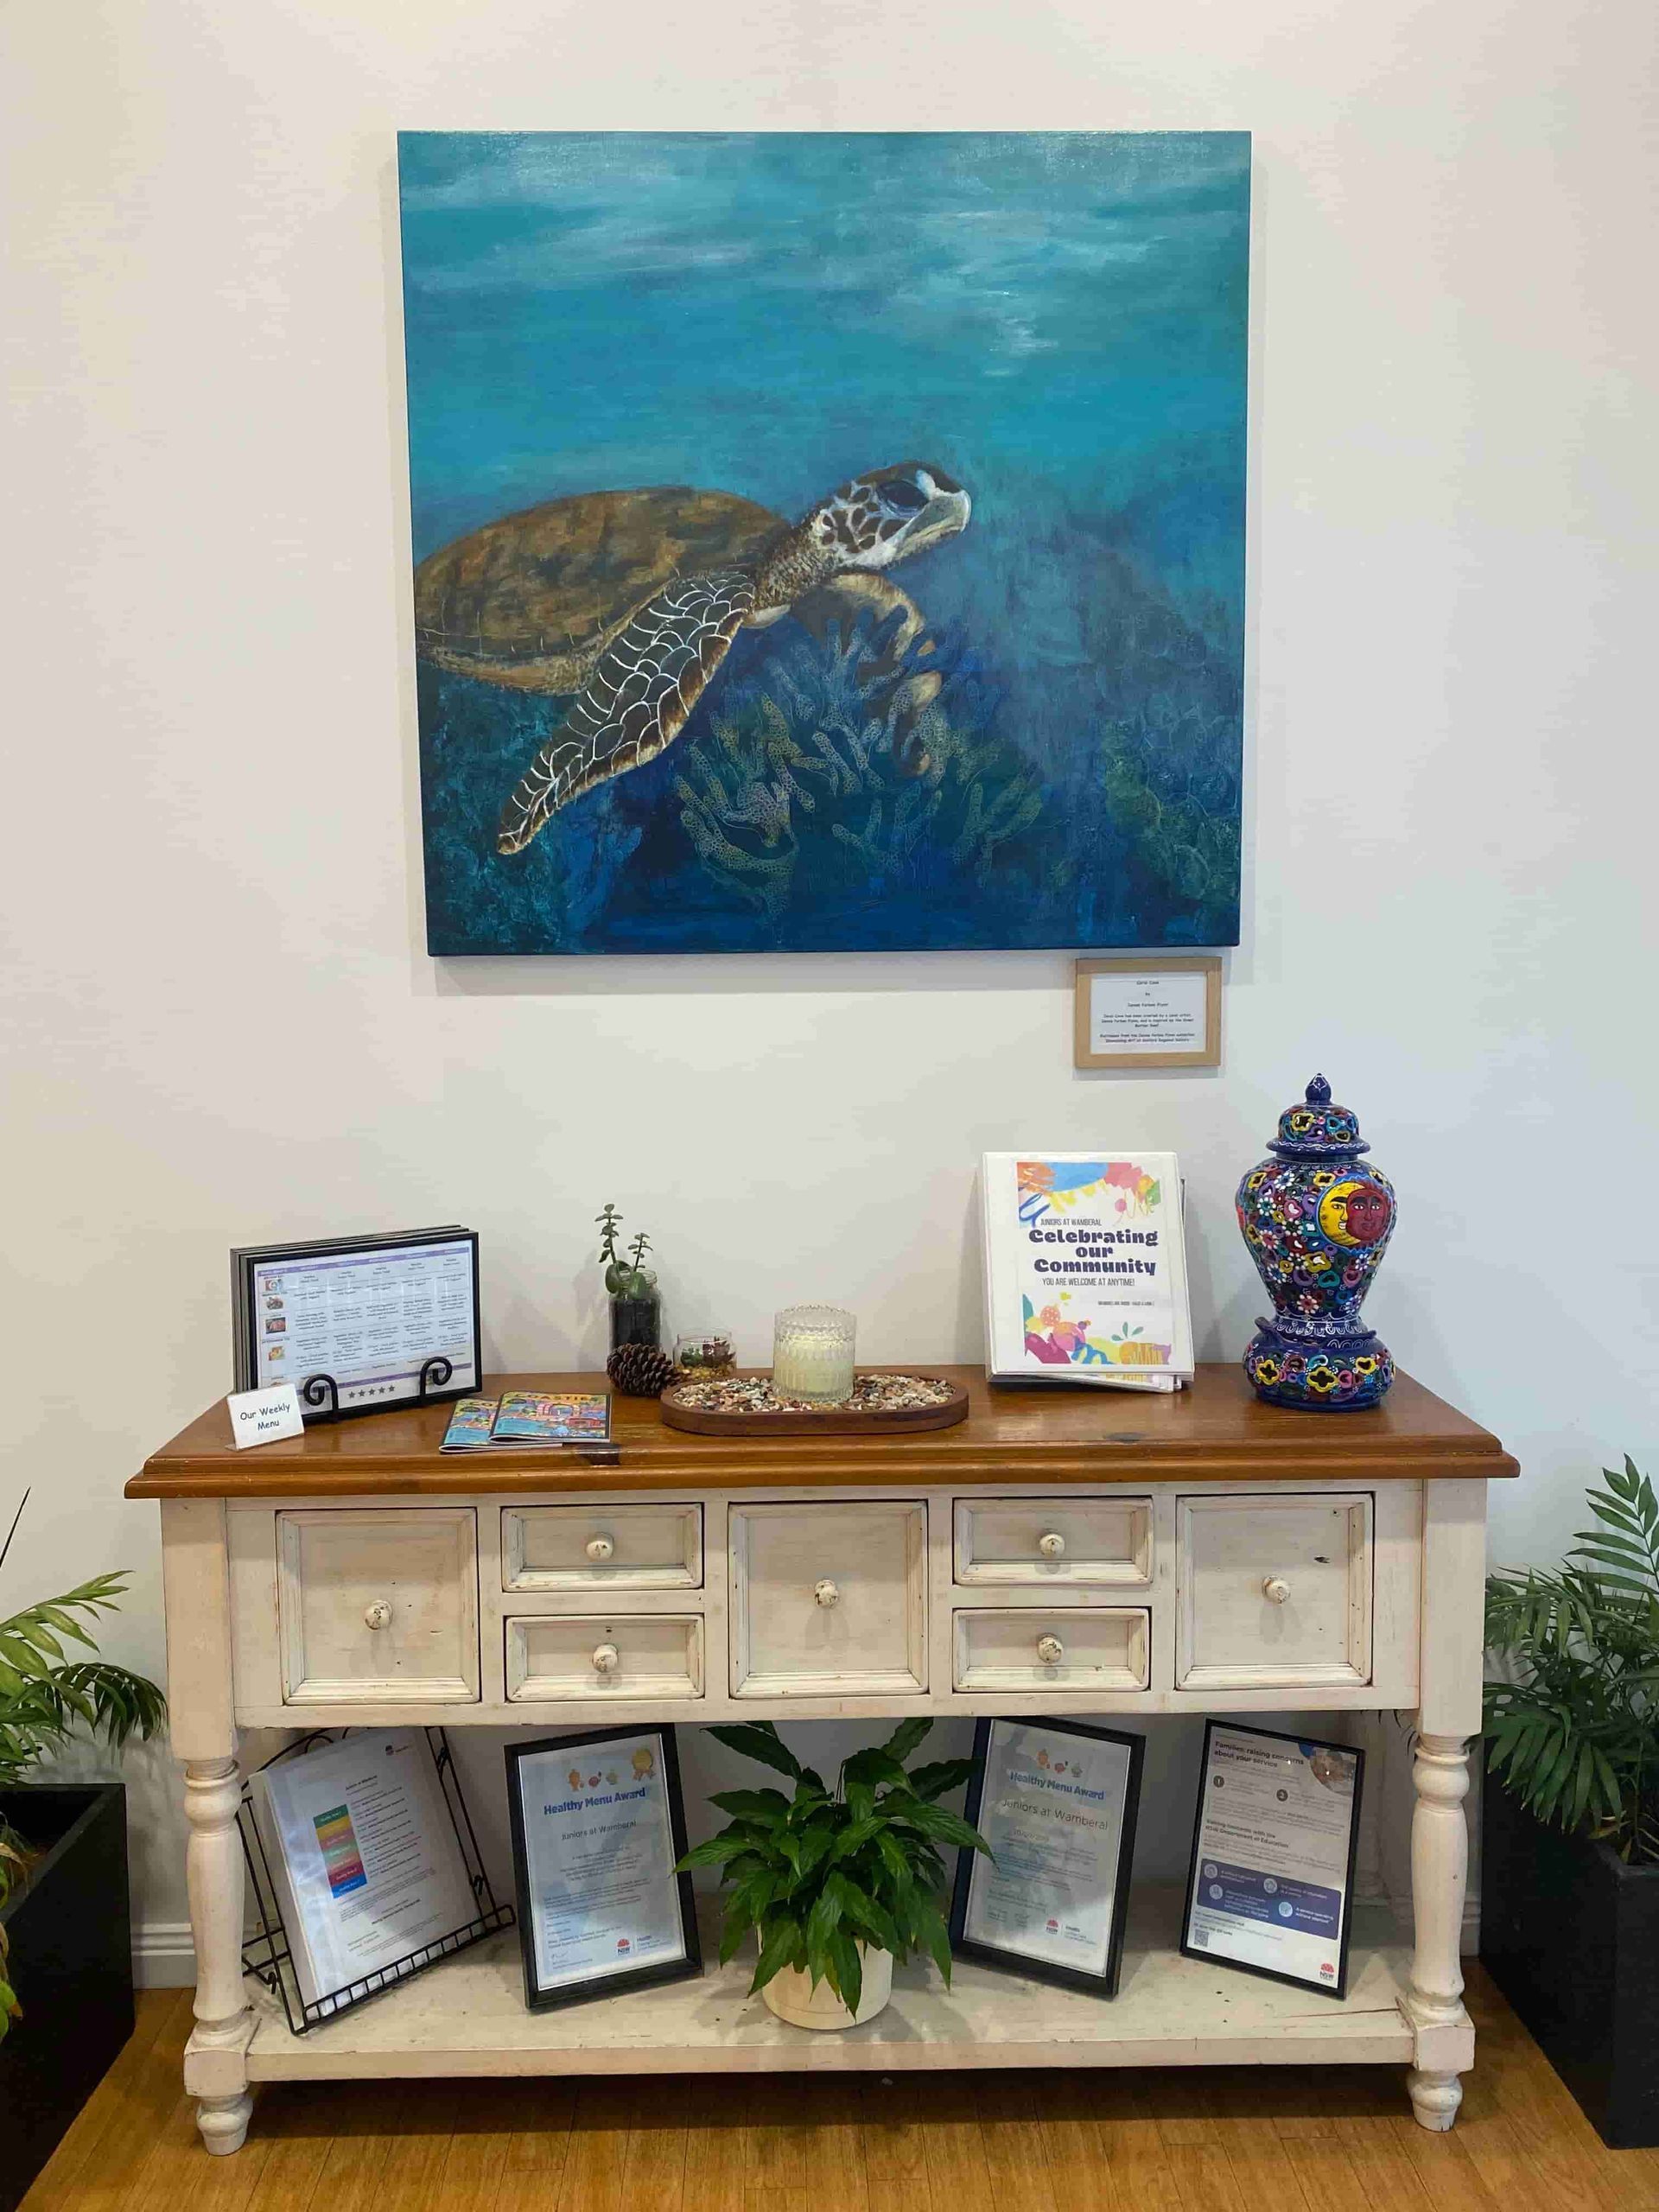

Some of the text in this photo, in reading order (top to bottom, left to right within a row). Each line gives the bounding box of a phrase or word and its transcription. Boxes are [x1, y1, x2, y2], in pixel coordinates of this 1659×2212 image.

[1028, 1229, 1159, 1247] Celebrating
[1075, 1246, 1114, 1258] our
[1033, 1258, 1157, 1276] Community
[1098, 1278, 1106, 1287] AT
[1108, 1278, 1135, 1287] ANYTIME!
[240, 1402, 290, 1420] Our Weekly
[257, 1420, 280, 1431] Menu
[1214, 1750, 1234, 1758] about
[1247, 1748, 1270, 1759] raising
[1009, 1771, 1105, 1800] Healthy Menu Award
[543, 1787, 646, 1815] Healthy Menu Award
[1002, 1798, 1108, 1830] Juniors at Wamberal
